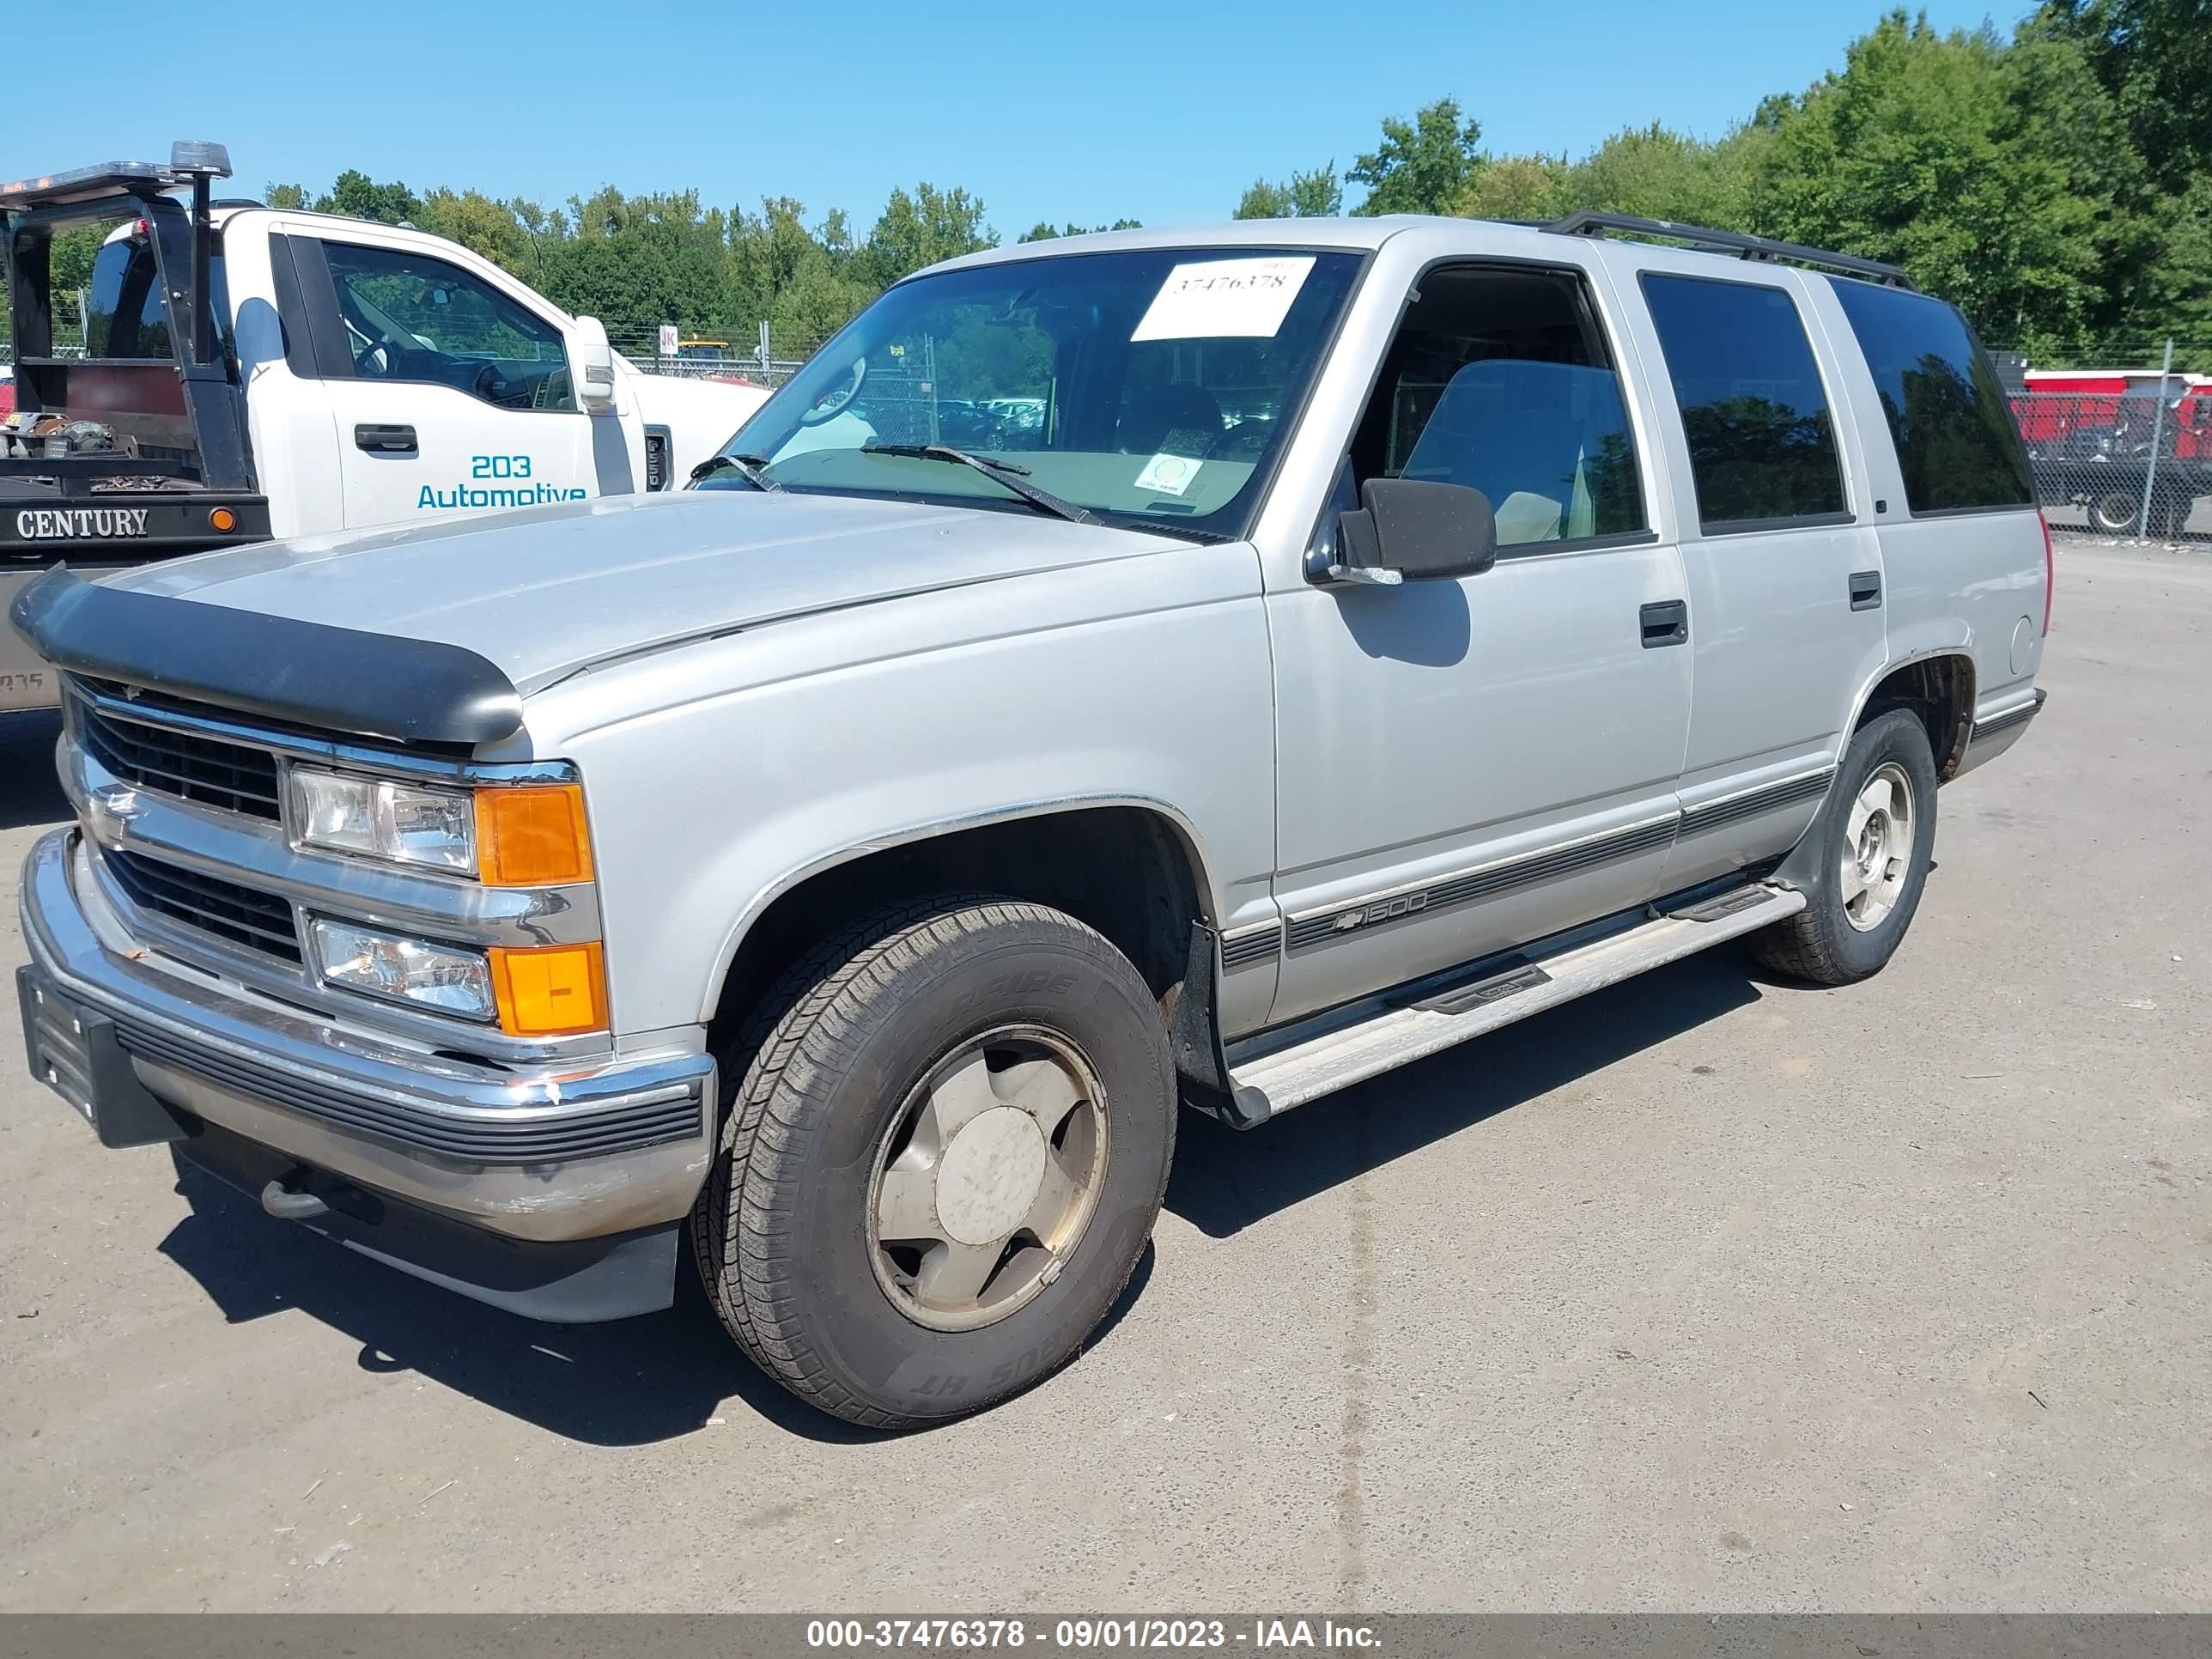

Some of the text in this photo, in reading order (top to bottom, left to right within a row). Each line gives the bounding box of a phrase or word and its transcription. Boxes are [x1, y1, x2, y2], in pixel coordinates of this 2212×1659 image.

[1173, 276, 1287, 294] 37476378
[662, 332, 675, 346] JK
[472, 456, 531, 478] 203
[417, 483, 586, 508] Automotive
[17, 509, 149, 538] CENTURY
[1363, 893, 1427, 923] 1500
